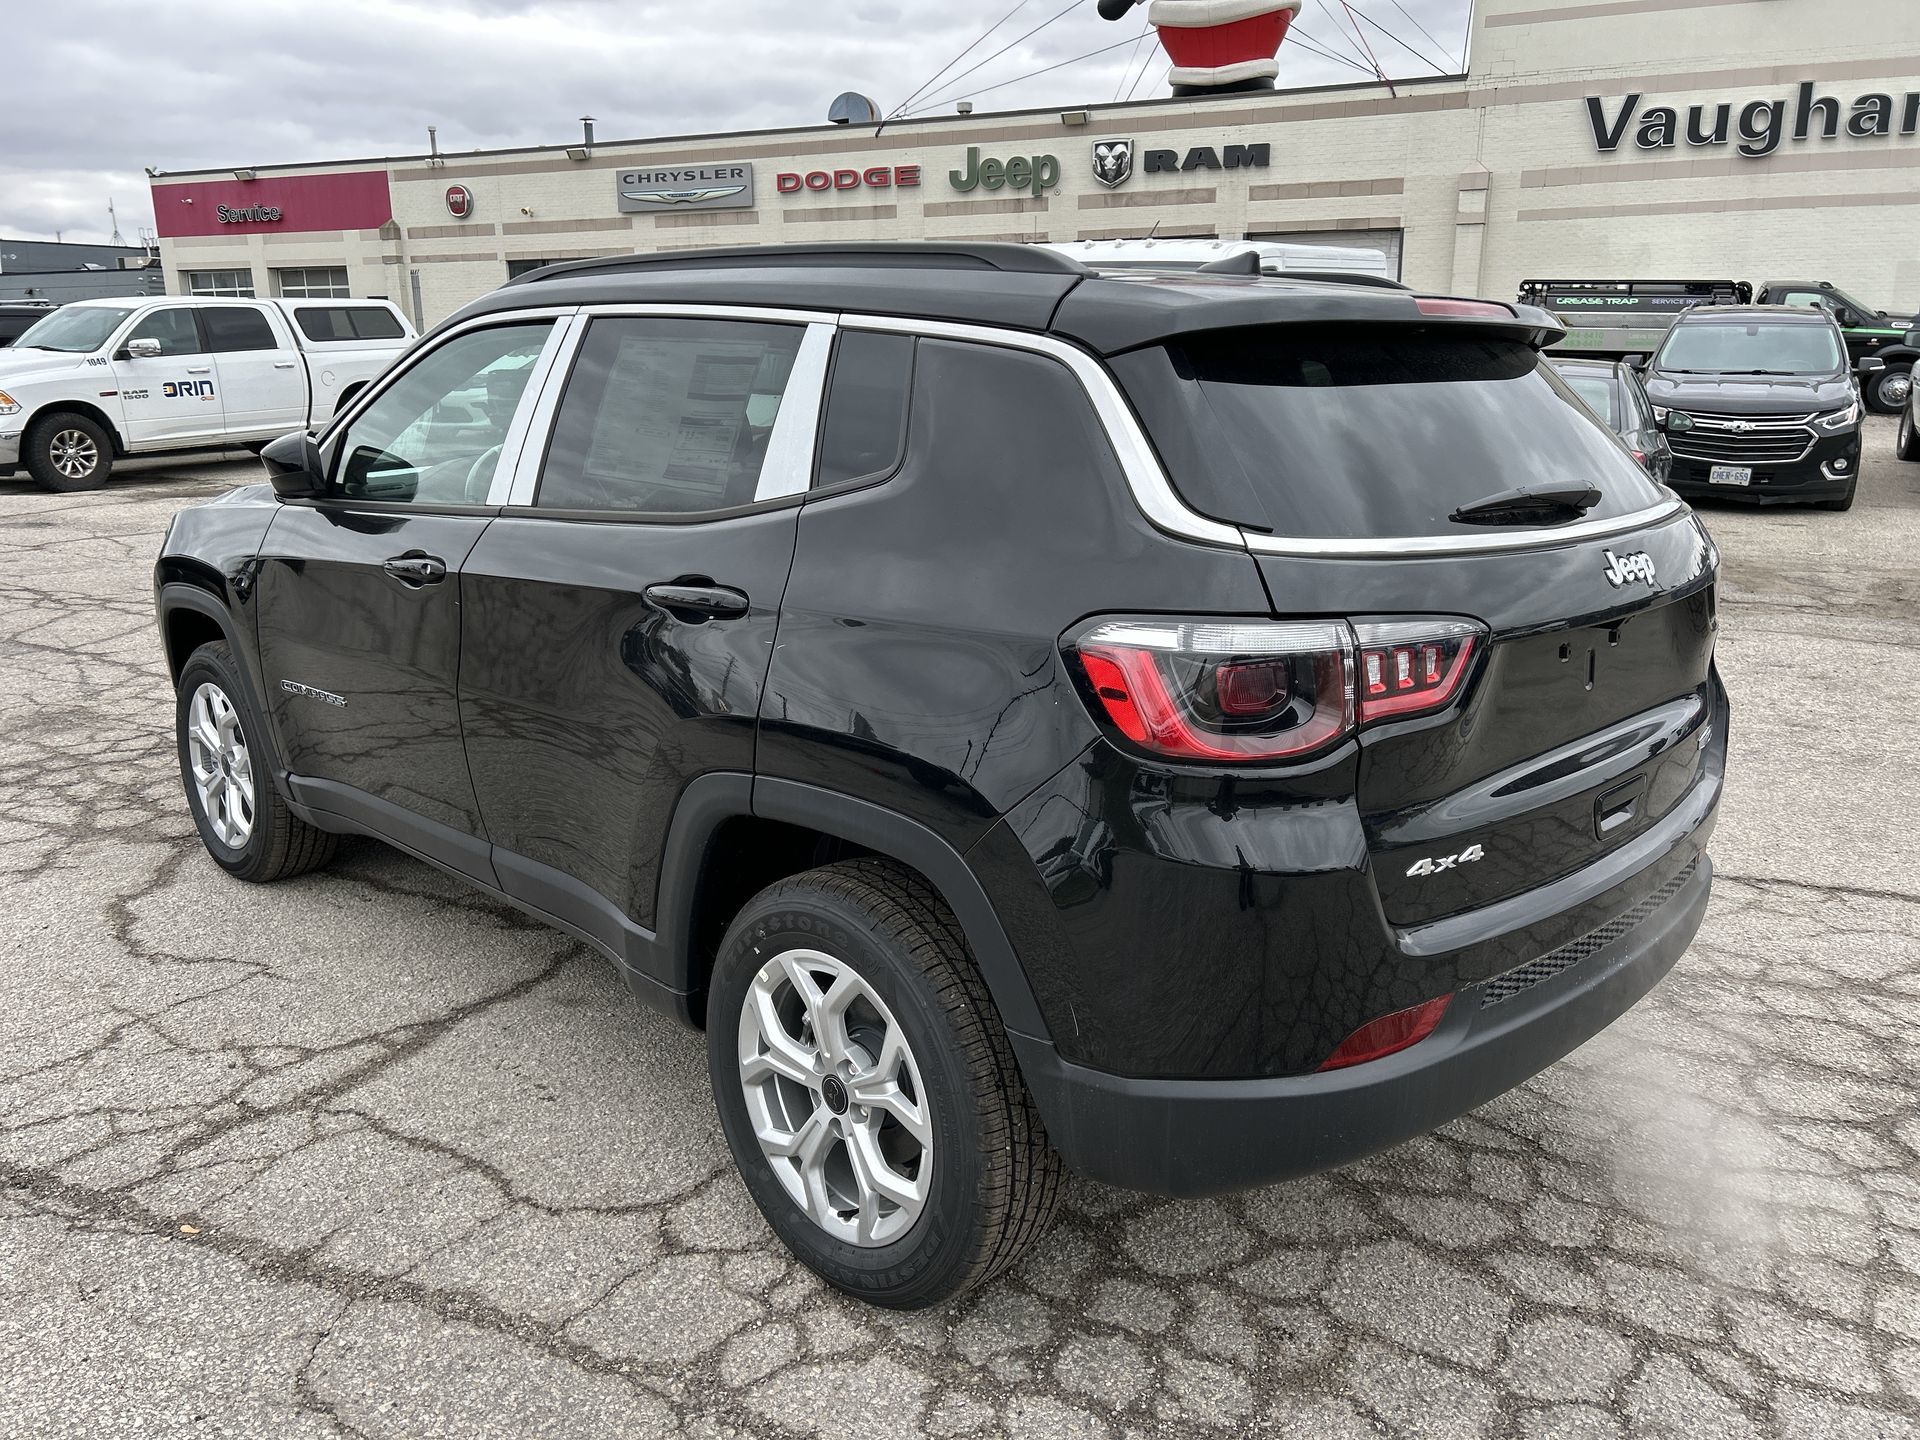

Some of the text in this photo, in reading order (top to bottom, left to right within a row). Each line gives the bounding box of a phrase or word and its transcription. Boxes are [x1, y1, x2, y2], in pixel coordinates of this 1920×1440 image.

[1144, 143, 1270, 172] RAM
[622, 168, 744, 185] CHRYSLER
[776, 165, 920, 193] DODGE
[948, 147, 1060, 197] Jeep
[216, 202, 282, 224] Service
[86, 357, 107, 366] 1049
[1602, 549, 1656, 588] Jeep
